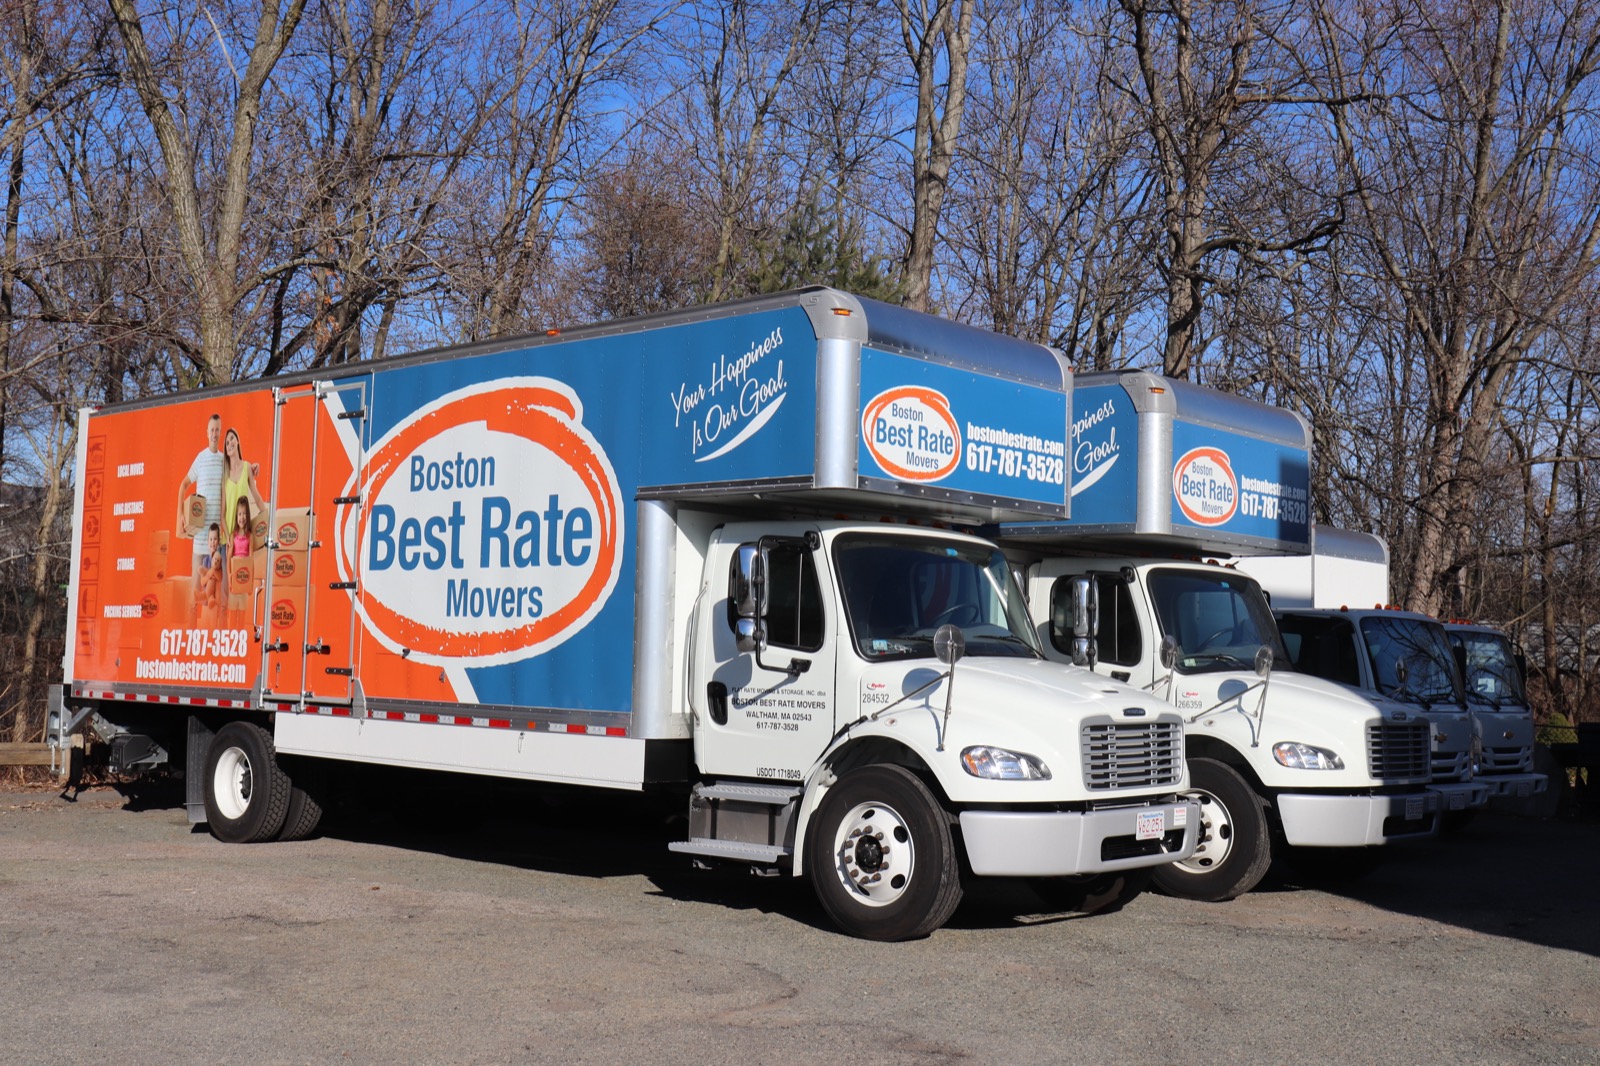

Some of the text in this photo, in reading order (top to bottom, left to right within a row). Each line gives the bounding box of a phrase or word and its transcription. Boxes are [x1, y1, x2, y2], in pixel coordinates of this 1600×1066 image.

[671, 327, 783, 427] Your Happiness
[692, 359, 787, 454] Is Our Goal.
[892, 403, 923, 422] Boston
[1072, 399, 1115, 444] ppiness
[876, 418, 953, 455] Best Rate
[967, 422, 1064, 457] bostonbestrate.com
[1074, 426, 1120, 473] Goal.
[906, 451, 939, 470] Movers
[966, 442, 1064, 485] 617-787-3528
[1192, 462, 1213, 476] Boston
[117, 464, 130, 478] LOCAL
[410, 452, 495, 492] Boston
[1182, 474, 1232, 503] Best Rate
[1242, 474, 1306, 500] bostonbestrate.com
[114, 501, 144, 516] LONG DISTANCE
[1202, 500, 1224, 515] Movers
[1241, 492, 1306, 524] 617-787-3528
[120, 519, 134, 532] MOVES
[369, 494, 593, 571] Best Rate
[117, 558, 135, 571] STORAGE
[446, 579, 543, 618] Movers
[104, 605, 142, 618] PACKING SERVICES
[272, 611, 294, 620] Best Rate
[160, 629, 247, 657] 617-787-3528
[136, 657, 246, 683] bostonbestrate.com
[732, 698, 826, 709] BOSTON BEST RATE MOVERS
[863, 693, 889, 703] 284532
[1178, 700, 1202, 709] 266359
[746, 711, 779, 720] WALTHAM,
[781, 712, 791, 720] MA
[757, 722, 799, 731] 617-787-3528
[757, 767, 800, 779] USDOT 1718049
[1151, 818, 1163, 832] 251
